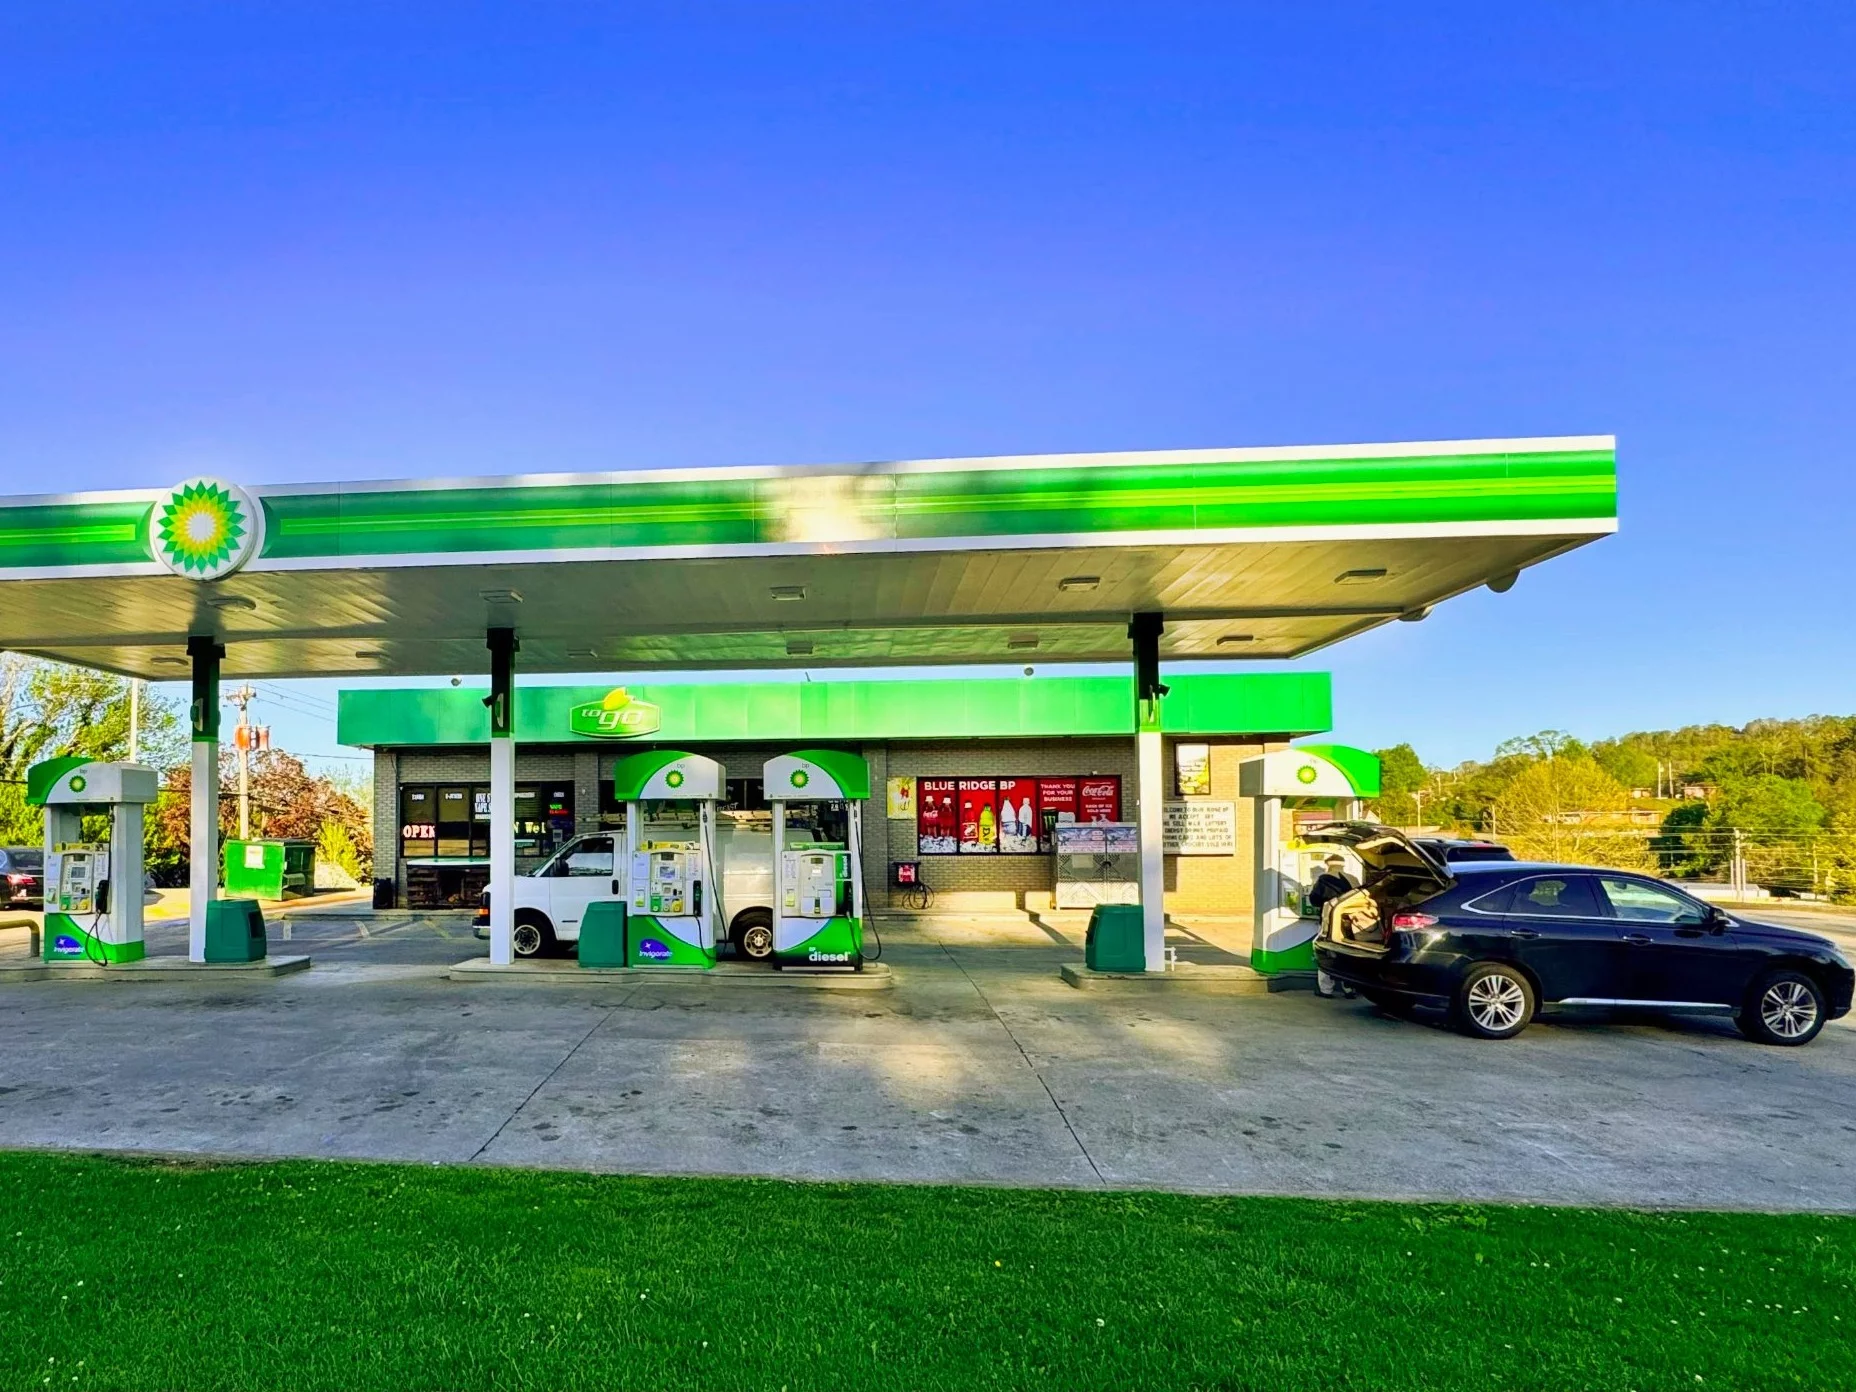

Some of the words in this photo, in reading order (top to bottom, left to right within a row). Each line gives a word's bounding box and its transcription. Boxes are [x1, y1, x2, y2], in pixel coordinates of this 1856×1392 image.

[596, 710, 643, 730] go
[924, 781, 955, 790] BLUE
[959, 781, 996, 790] RIDGE
[1000, 781, 1016, 790] BP
[808, 951, 850, 962] diesel
